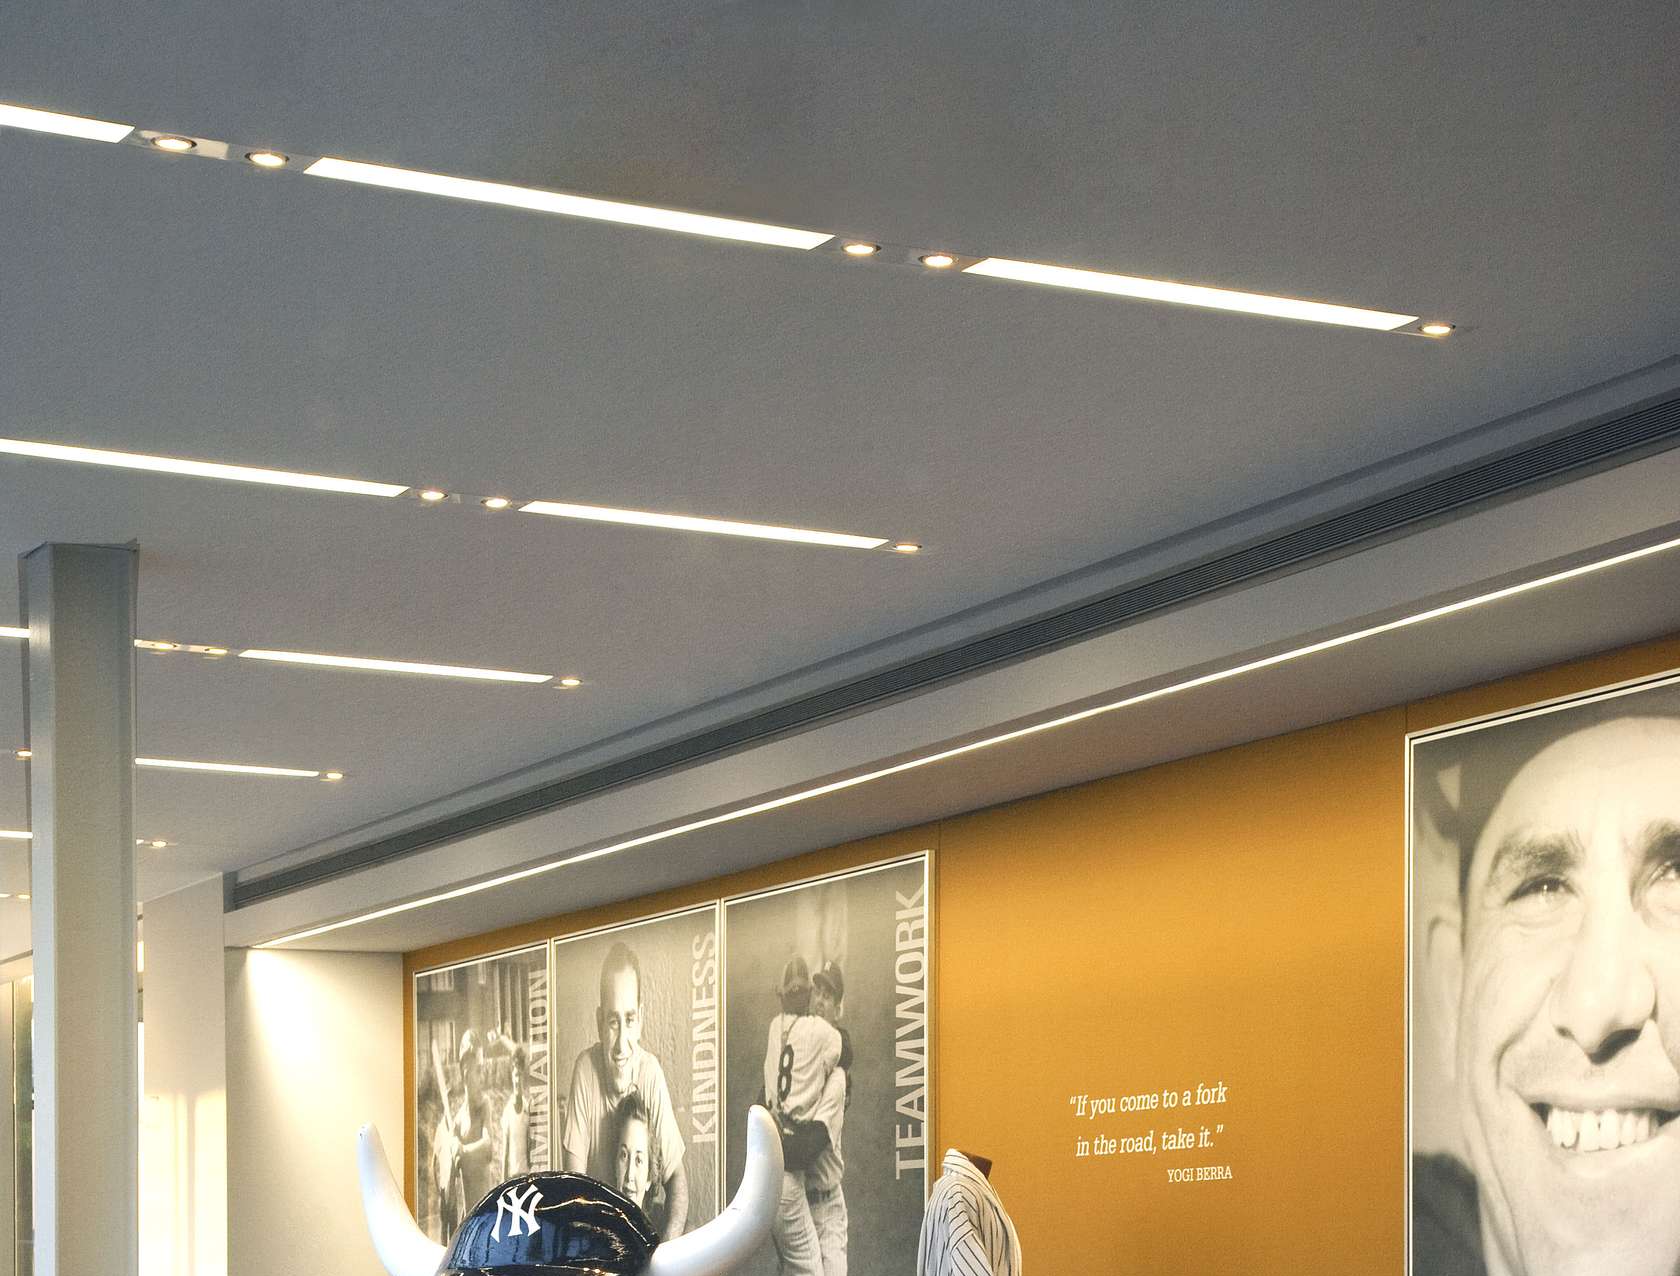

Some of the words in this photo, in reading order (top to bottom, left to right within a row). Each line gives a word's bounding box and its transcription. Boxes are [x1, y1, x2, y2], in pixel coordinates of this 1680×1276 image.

[692, 931, 715, 1144] KINDNESS
[895, 883, 925, 1180] TEAMWORK
[777, 1044, 794, 1102] 8
[1089, 1097, 1116, 1120] you
[1120, 1093, 1159, 1112] come
[1162, 1089, 1178, 1108] to
[1182, 1092, 1192, 1107] a
[1195, 1081, 1228, 1105] fork
[1075, 1136, 1090, 1157] in
[1093, 1134, 1117, 1156] the
[1119, 1130, 1157, 1155] road,
[1161, 1127, 1195, 1151] take
[1167, 1168, 1194, 1183] YOGI
[1196, 1165, 1233, 1181] BERRA
[490, 1184, 544, 1243] NY
